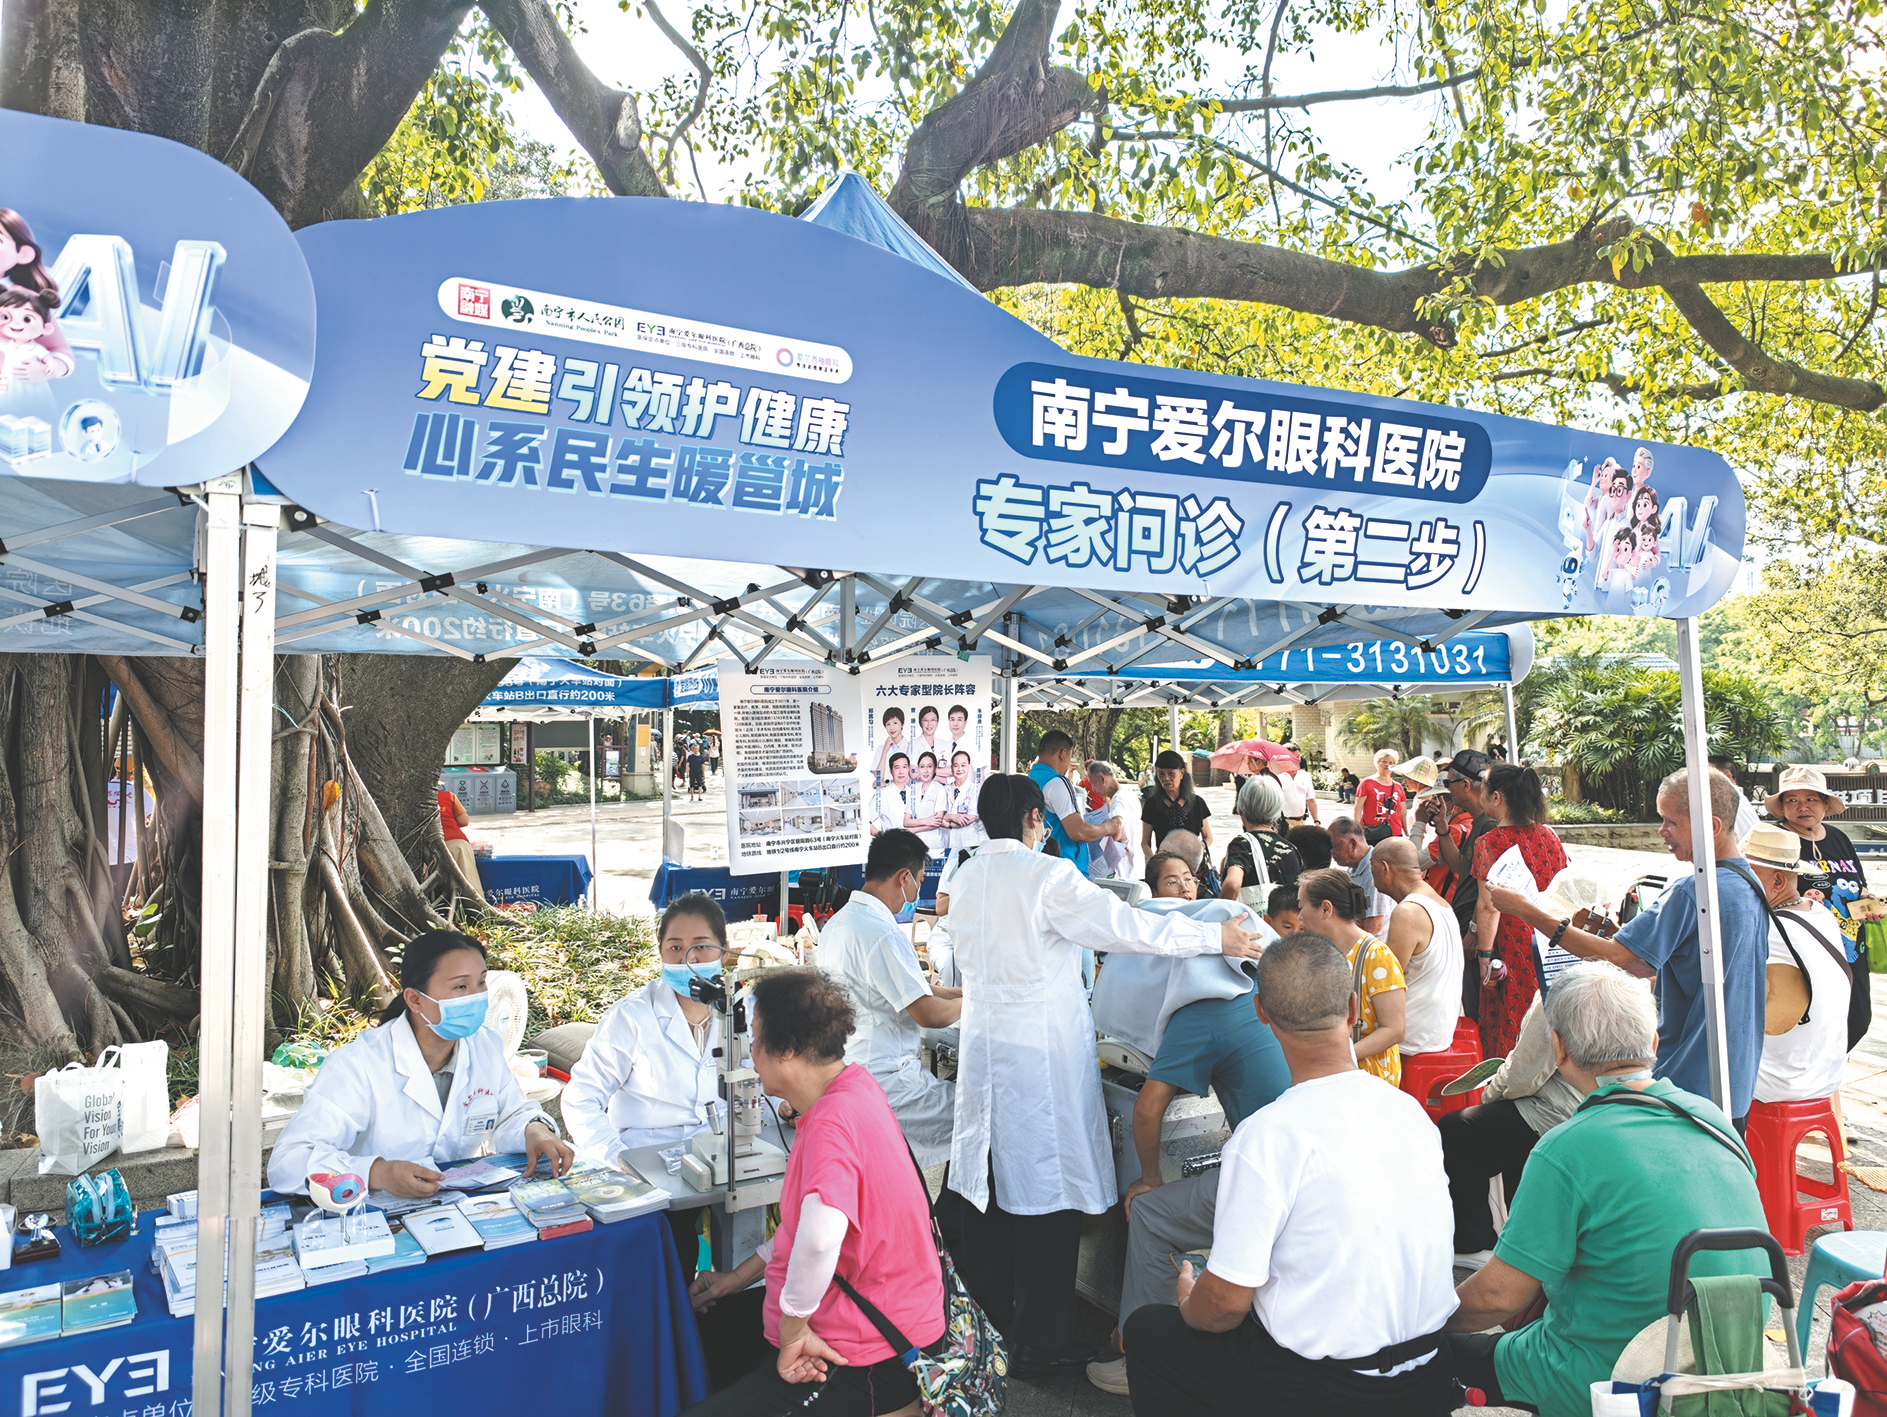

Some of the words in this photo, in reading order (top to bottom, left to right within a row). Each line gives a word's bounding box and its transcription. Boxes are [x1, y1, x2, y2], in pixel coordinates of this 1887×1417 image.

[541, 304, 625, 330] 南宁市人民公园
[415, 333, 851, 458] 党建引领护健康
[1030, 377, 1467, 492] 南宁爱尔眼科医院
[402, 411, 847, 521] 心系民生暖邕城
[973, 473, 1487, 596] 专家问诊（第二步）
[875, 683, 976, 697] 六大专家型院长阵容
[83, 1126, 101, 1140] For
[84, 1109, 111, 1124] Vision
[83, 1139, 110, 1156] Vision
[250, 1267, 605, 1357] 爱尔眼科医院（广西总院）
[285, 1348, 328, 1368] AIER
[336, 1338, 368, 1357] EYE
[376, 1321, 457, 1347] HOSPITAL
[404, 1332, 495, 1375] 全国连锁
[517, 1308, 604, 1346] 上市眼科
